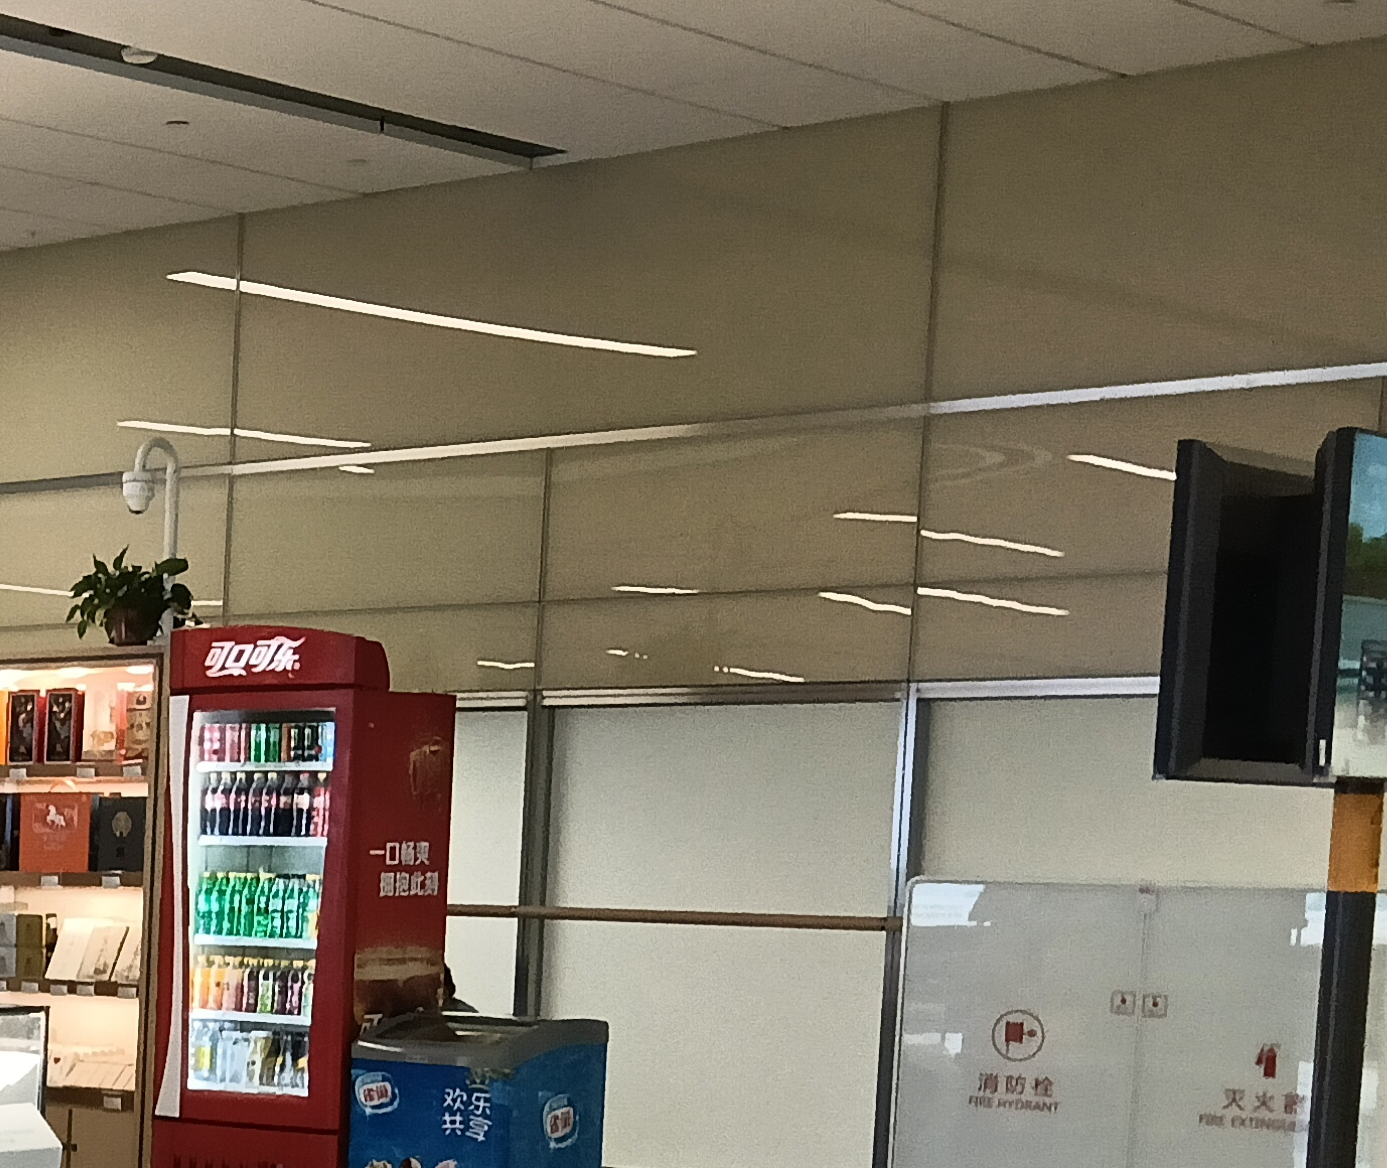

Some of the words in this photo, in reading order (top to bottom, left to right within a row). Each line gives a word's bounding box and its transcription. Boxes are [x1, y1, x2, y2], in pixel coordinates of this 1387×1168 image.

[204, 636, 305, 677] 可口可乐
[978, 1072, 1054, 1098] 消防栓
[443, 1087, 492, 1115] 欢乐
[441, 1112, 493, 1142] 共享
